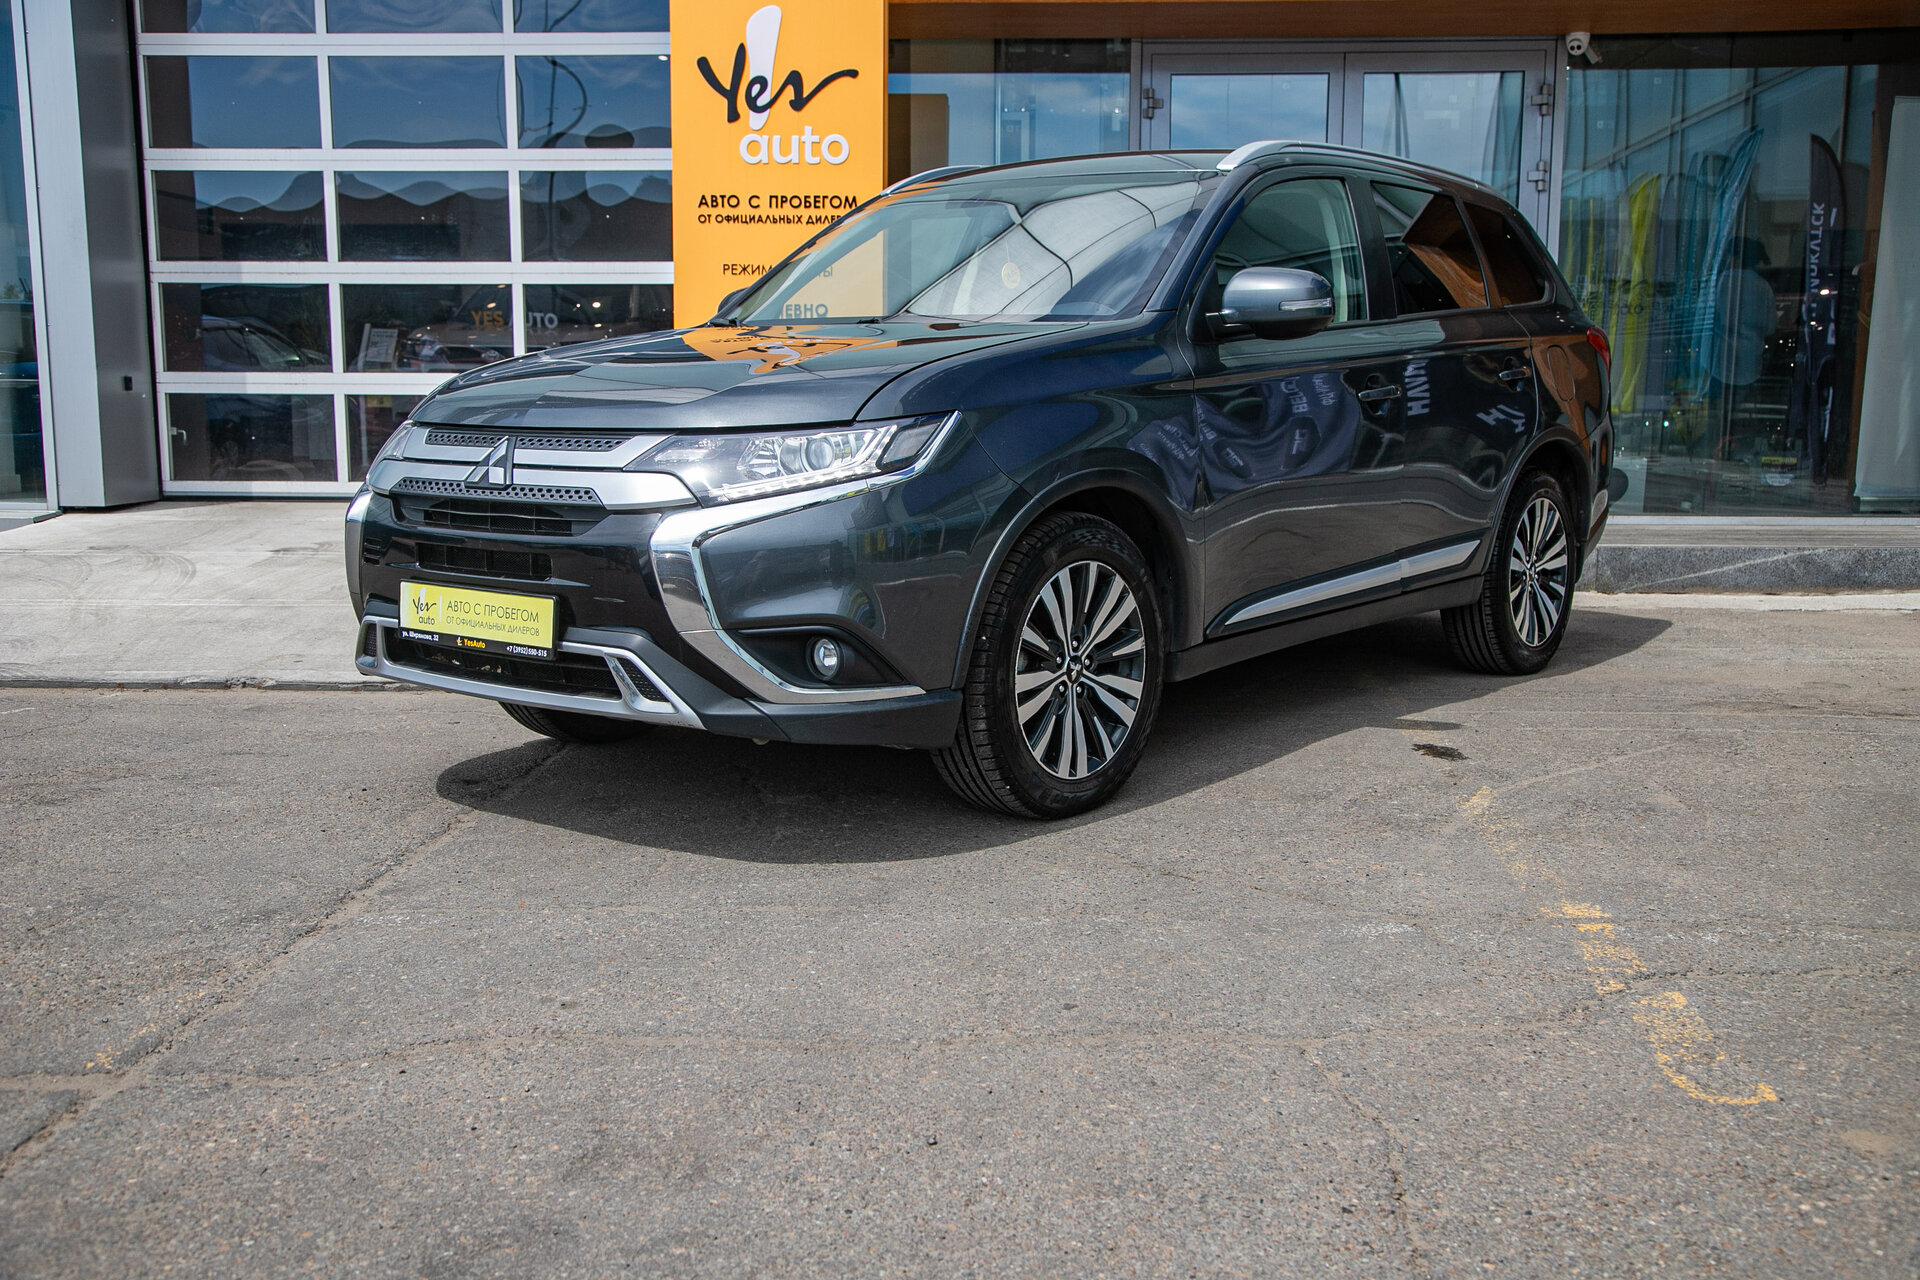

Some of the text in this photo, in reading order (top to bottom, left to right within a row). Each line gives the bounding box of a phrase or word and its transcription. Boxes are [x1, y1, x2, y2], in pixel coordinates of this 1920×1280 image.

[697, 42, 859, 123] Yes
[739, 126, 850, 165] auto
[698, 195, 858, 209] АВТО С ПРОБЕГОМ
[698, 214, 712, 224] ОТ
[715, 214, 802, 225] ОФИЦИАЛЬНЫХ
[723, 264, 773, 275] РЕЖИМ
[472, 310, 559, 329] YES UTO
[412, 596, 437, 614] Yes
[446, 600, 539, 623] АВТО С ПРОБЕГОМ
[418, 616, 436, 625] auto
[446, 616, 540, 637] ОТ ОФИЦИАЛЬНЫХ ДИЛЕРОВ
